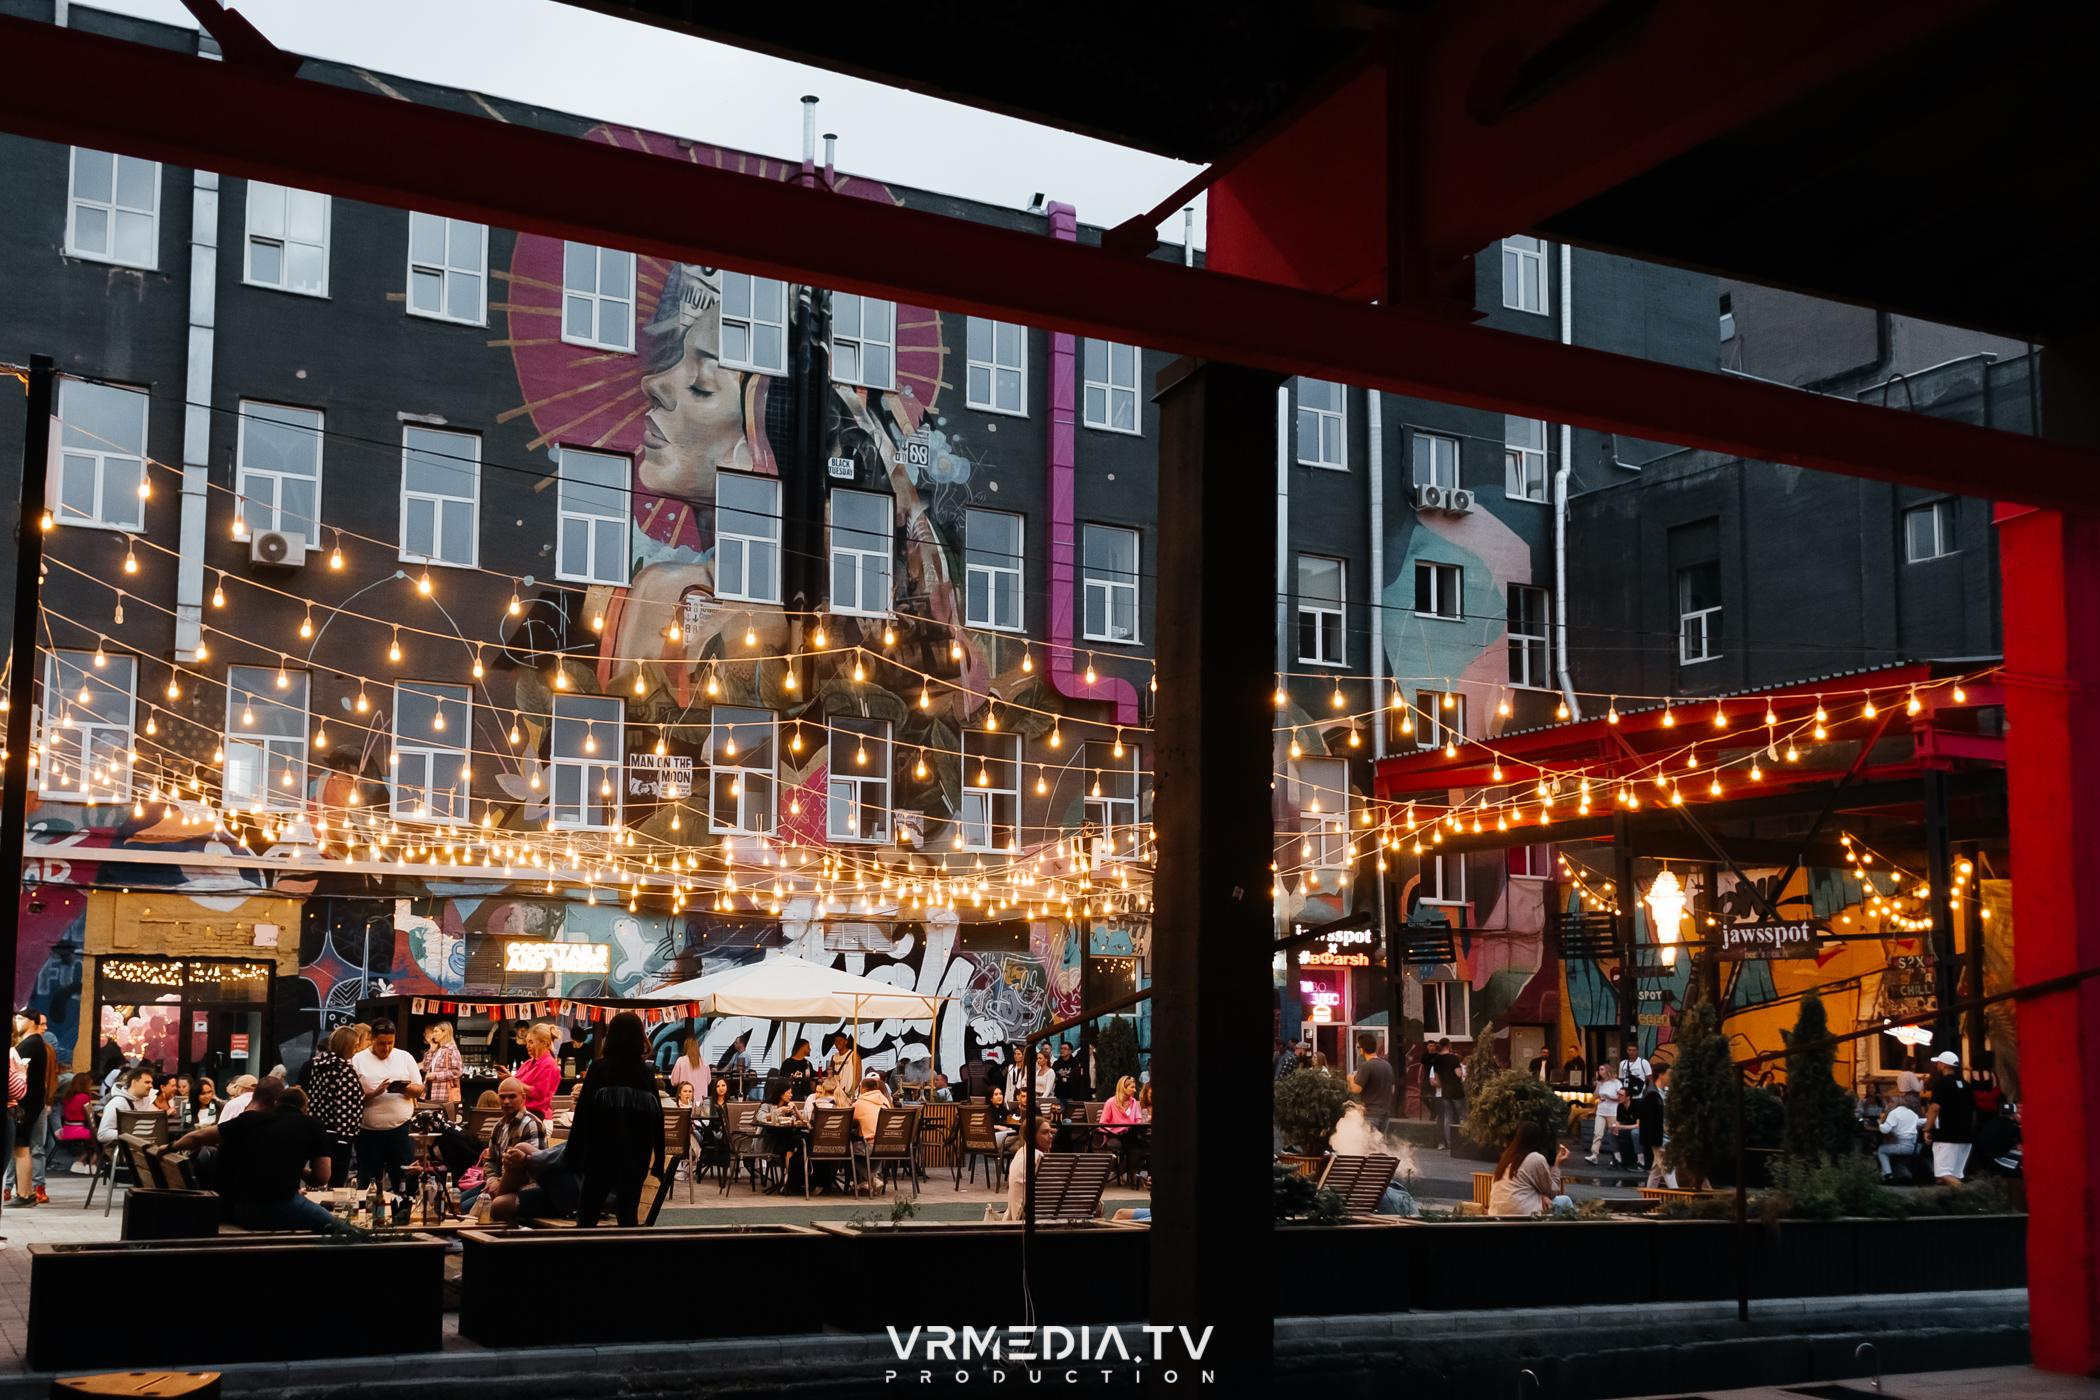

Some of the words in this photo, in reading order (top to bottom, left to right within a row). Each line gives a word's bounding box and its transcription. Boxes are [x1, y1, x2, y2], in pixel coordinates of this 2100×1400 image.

[832, 458, 851, 467] BLACK
[828, 466, 853, 476] TUESDAY
[631, 754, 654, 768] MAN
[657, 757, 671, 768] ON
[674, 757, 692, 769] THE
[661, 770, 691, 784] MOON
[1295, 924, 1372, 946] jsspot
[1722, 922, 1810, 950] jawsspot
[507, 943, 609, 958] COCKTAILS
[506, 956, 547, 971] AND
[1638, 990, 1663, 1001] SPOT
